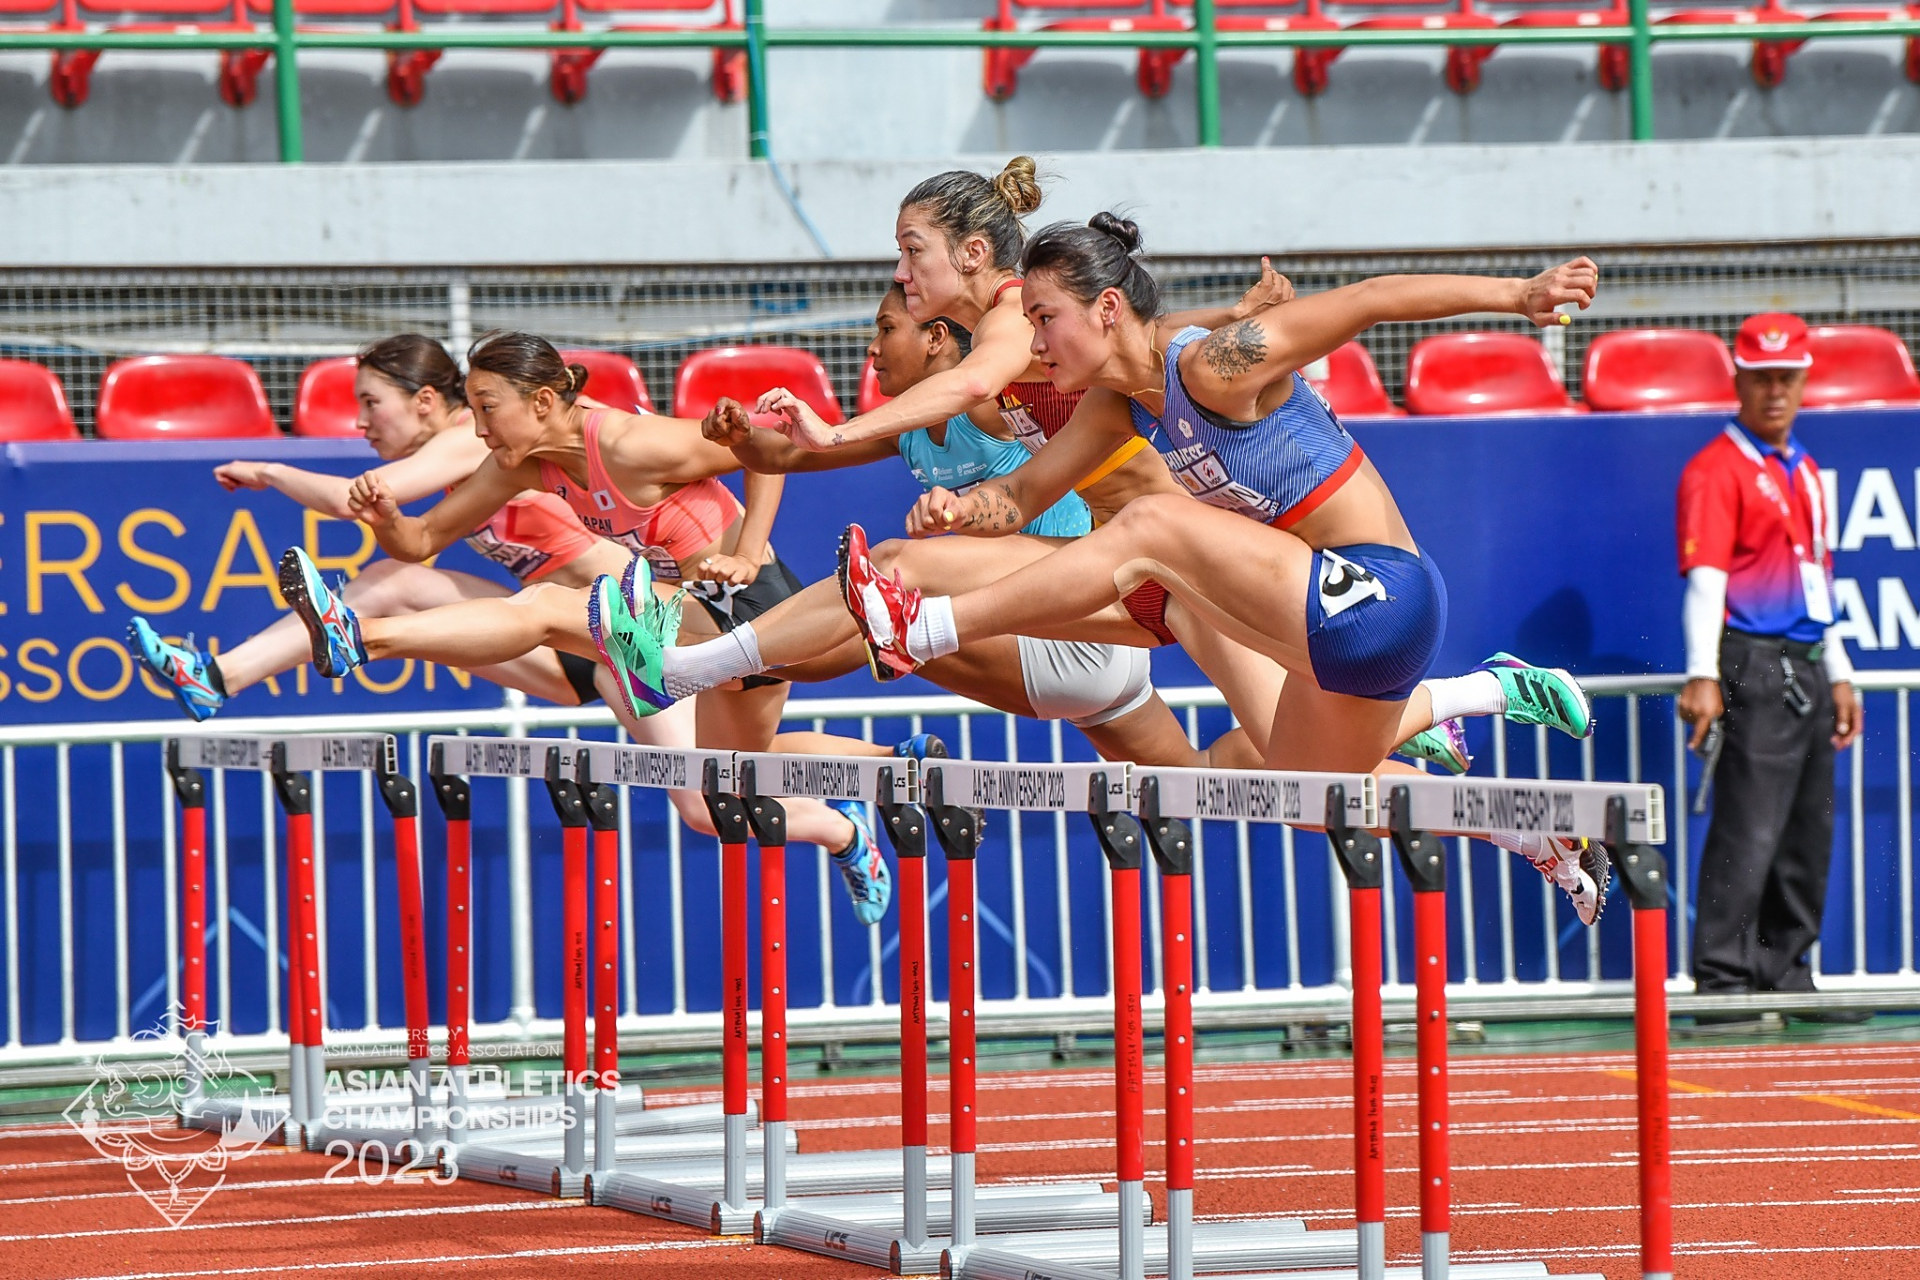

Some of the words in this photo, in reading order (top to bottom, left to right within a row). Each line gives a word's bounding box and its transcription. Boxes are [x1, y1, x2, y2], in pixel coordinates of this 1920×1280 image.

[805, 761, 845, 797] ANNIVERSARY
[846, 763, 860, 798] 2023
[972, 769, 982, 804] AA
[983, 769, 997, 806] 50th
[998, 770, 1047, 807] ANNIVERSARY
[1048, 771, 1065, 808] 2023
[1226, 778, 1281, 818] ANNIVERSARY
